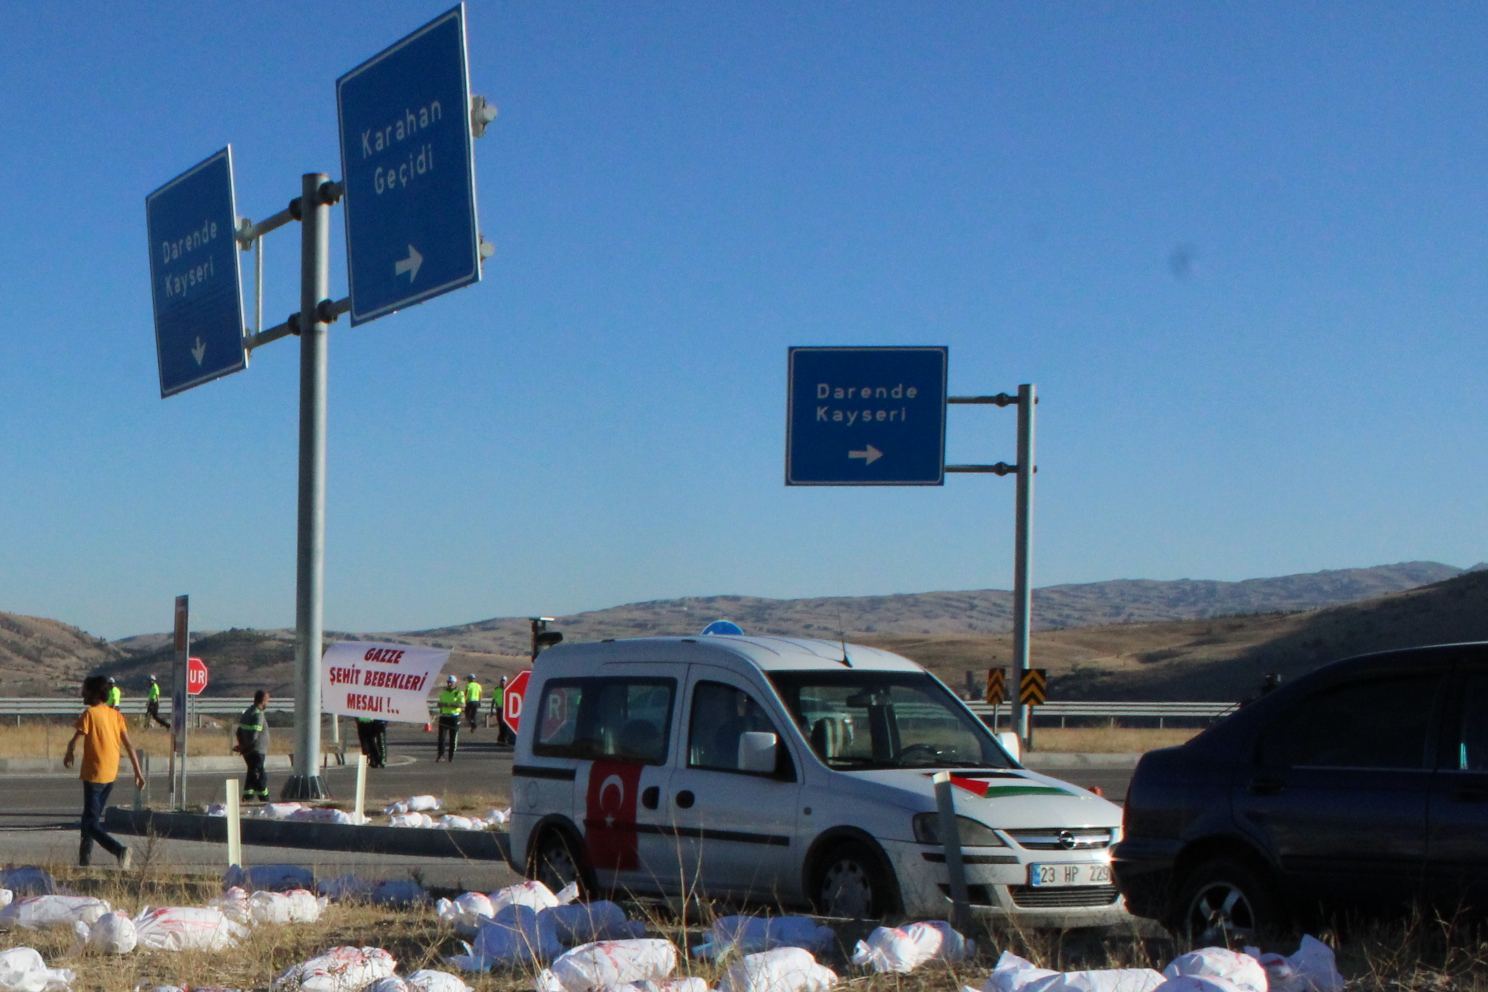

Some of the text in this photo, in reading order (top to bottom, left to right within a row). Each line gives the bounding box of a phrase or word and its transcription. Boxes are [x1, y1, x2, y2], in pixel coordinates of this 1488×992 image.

[361, 100, 442, 159] Karahan
[373, 143, 433, 195] Geçidi
[162, 219, 217, 264] Darende
[165, 255, 214, 298] Kayseri
[816, 383, 918, 399] Darende
[816, 406, 906, 426] Kayseri
[364, 647, 405, 664] GAZZE
[329, 663, 429, 691] ŞEHİT BEBEKLERİ
[347, 693, 383, 713] MESAJI
[509, 692, 561, 719] DR
[1040, 865, 1110, 883] 23 HP 229
